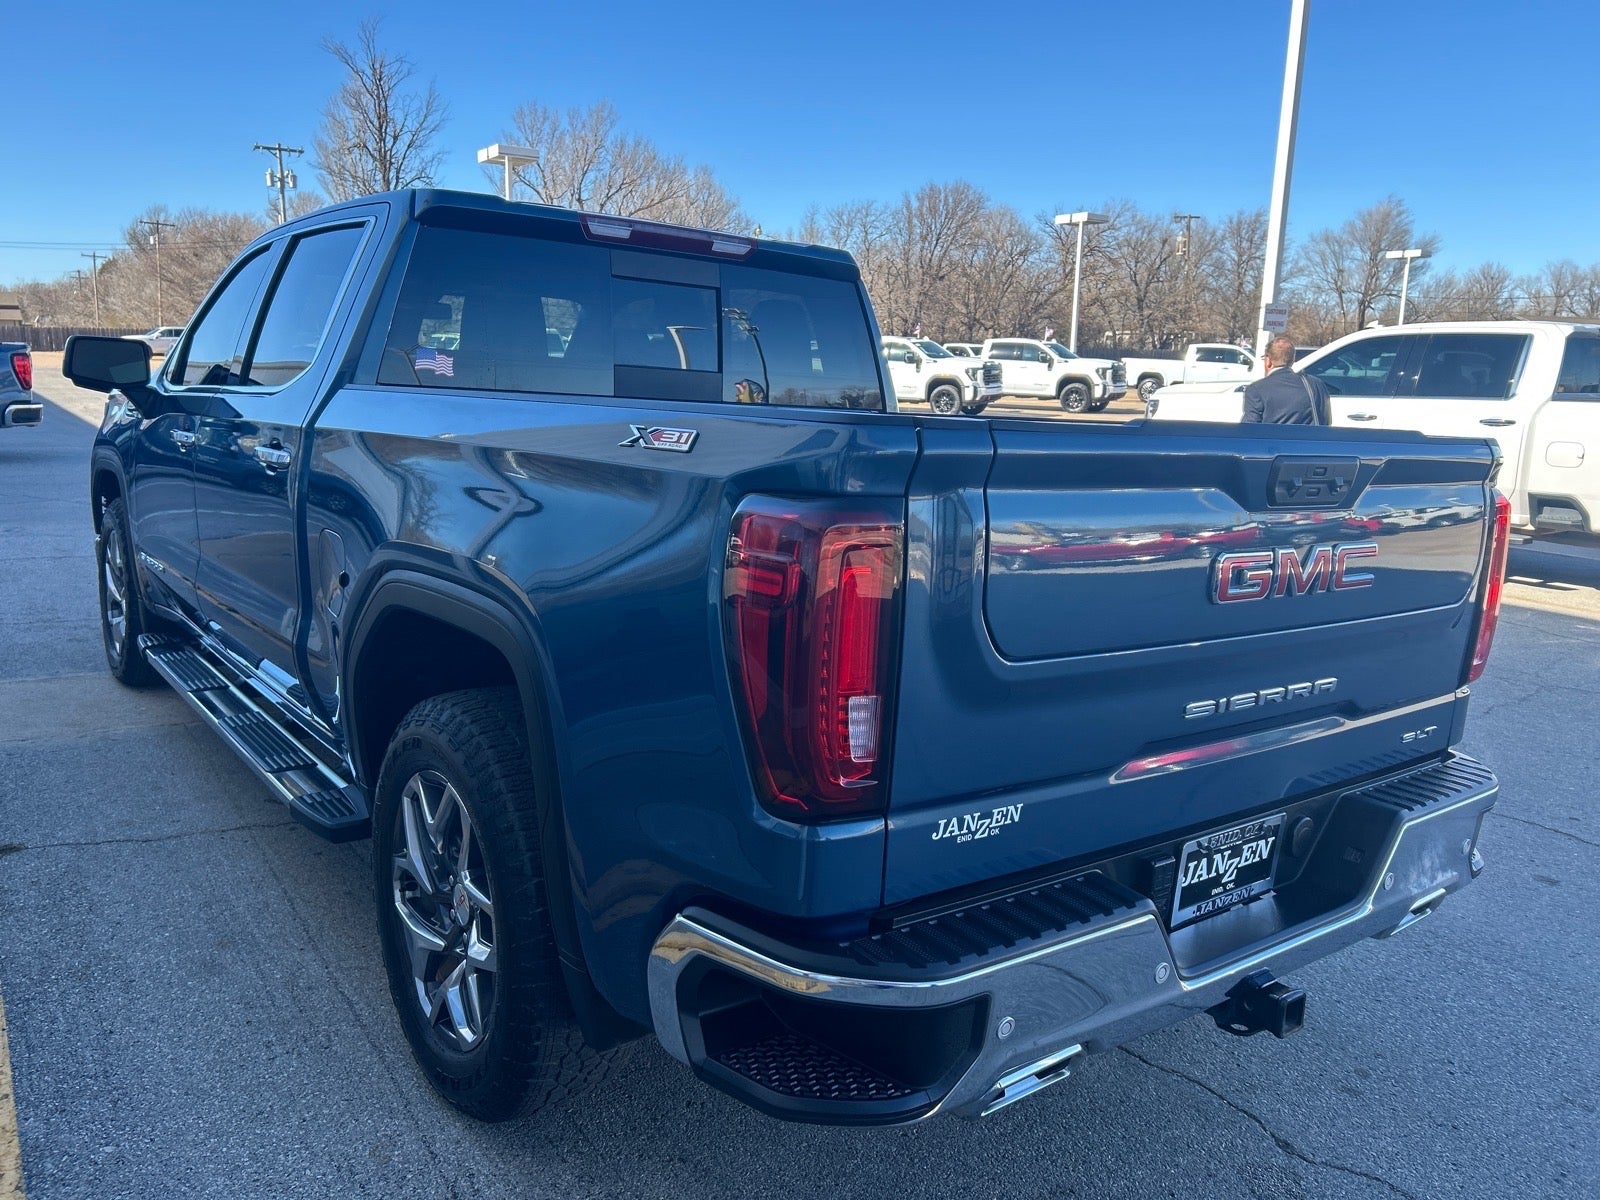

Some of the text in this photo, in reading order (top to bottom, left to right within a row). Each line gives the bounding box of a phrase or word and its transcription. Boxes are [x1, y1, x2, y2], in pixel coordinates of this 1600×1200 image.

[1208, 541, 1378, 604] GMC
[1184, 677, 1338, 718] SIERRA
[1401, 725, 1438, 743] SLT
[931, 803, 1024, 840] JANZEN
[957, 827, 1000, 843] ENID OK
[1181, 836, 1276, 888] JANZEN
[1196, 887, 1251, 916] JANZEN
